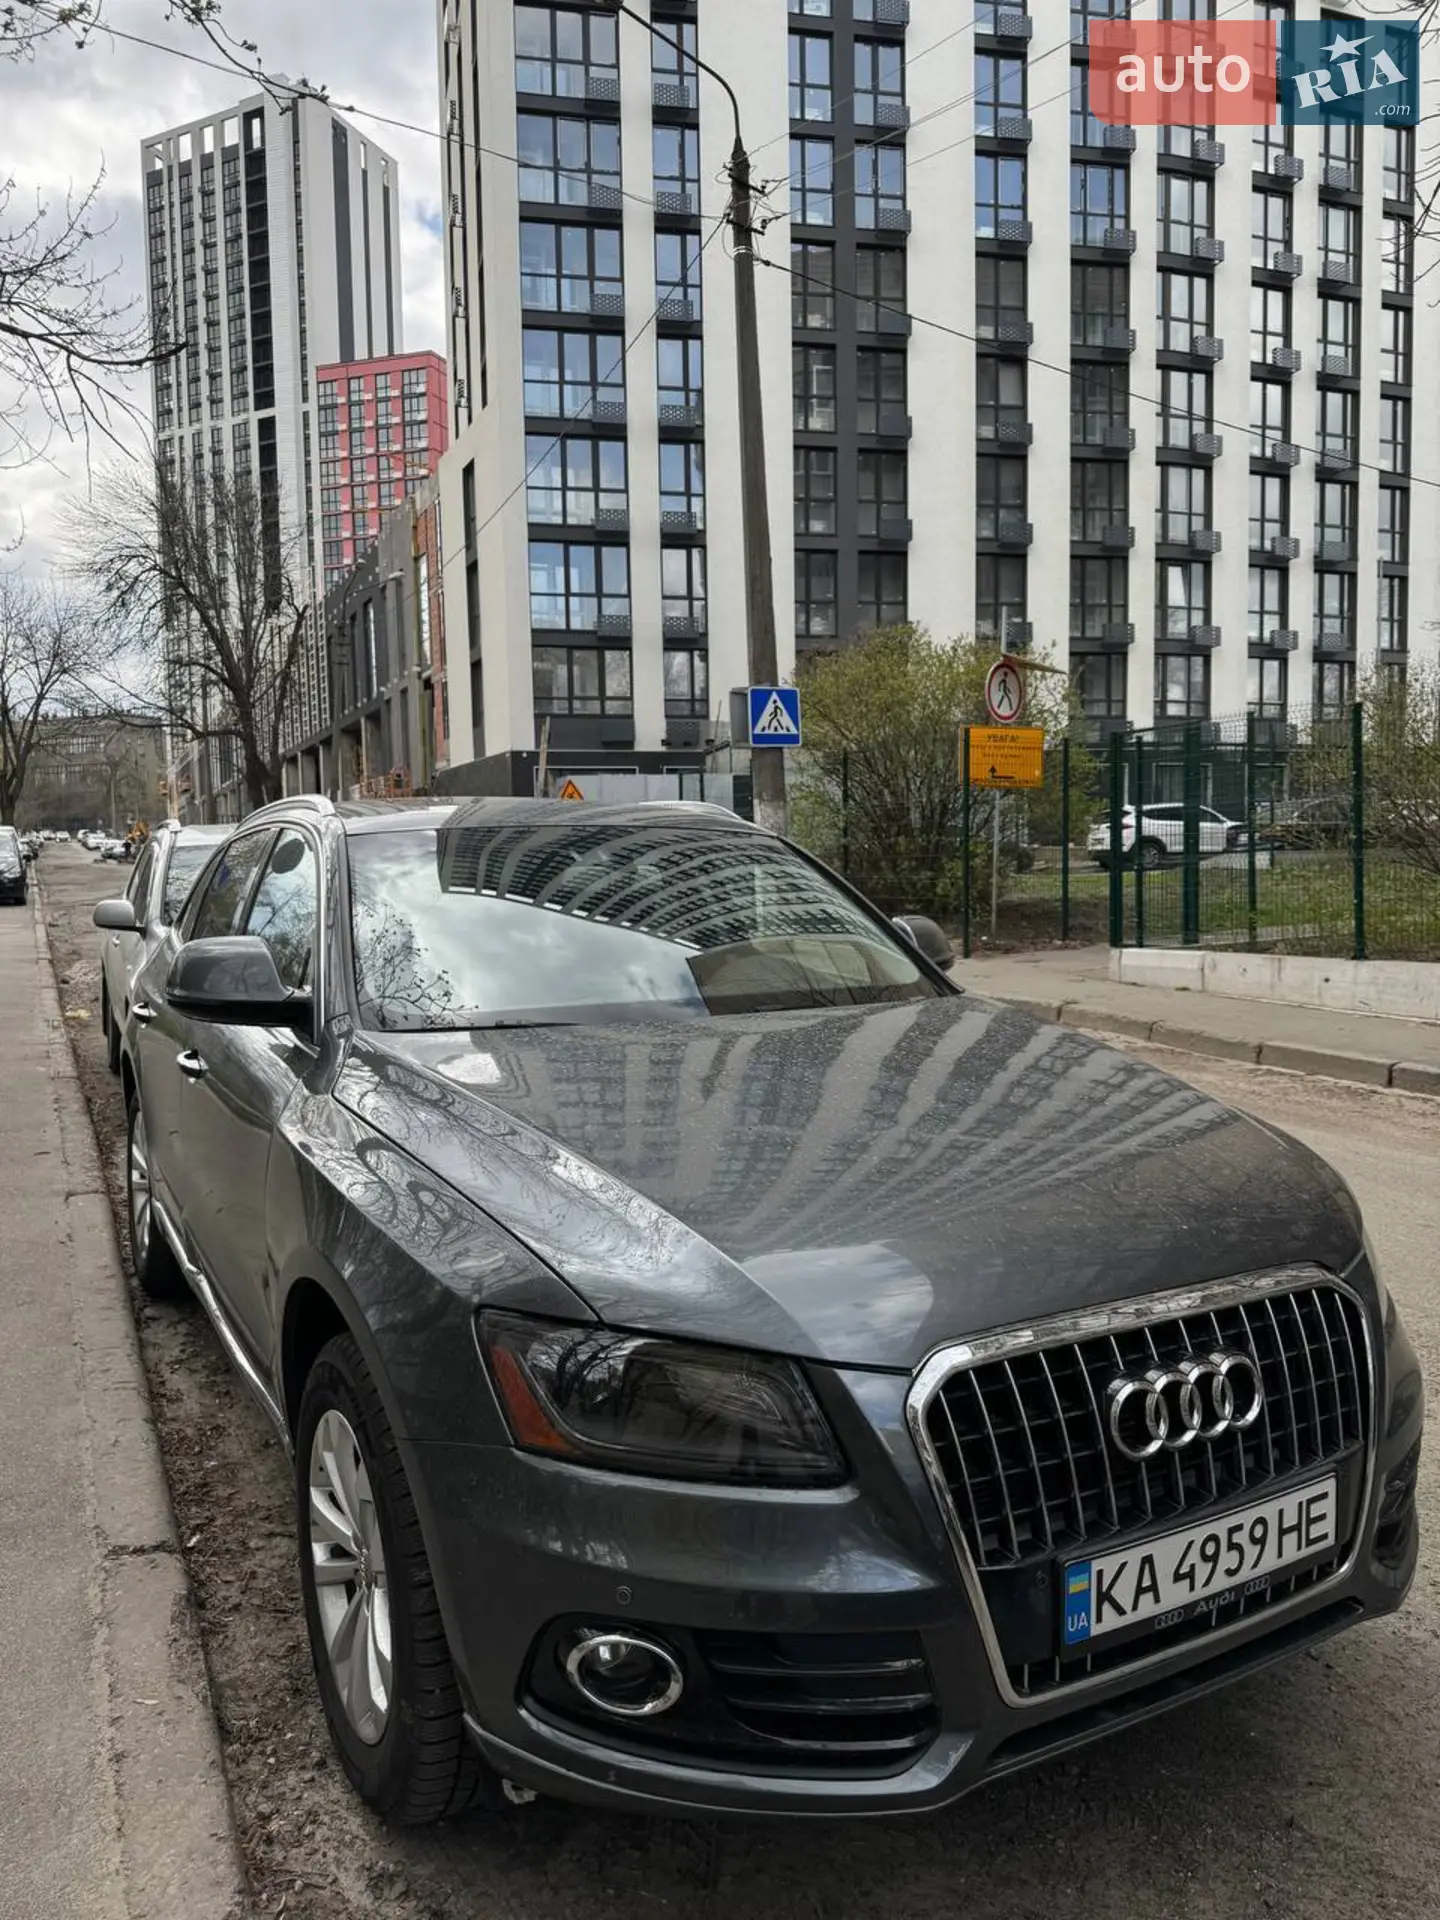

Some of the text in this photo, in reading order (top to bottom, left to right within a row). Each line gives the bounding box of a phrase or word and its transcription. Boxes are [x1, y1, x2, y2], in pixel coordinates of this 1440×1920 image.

[1095, 1491, 1329, 1625] KA 4959 HE
[1193, 1590, 1236, 1615] Audi
[1068, 1612, 1089, 1632] UA
